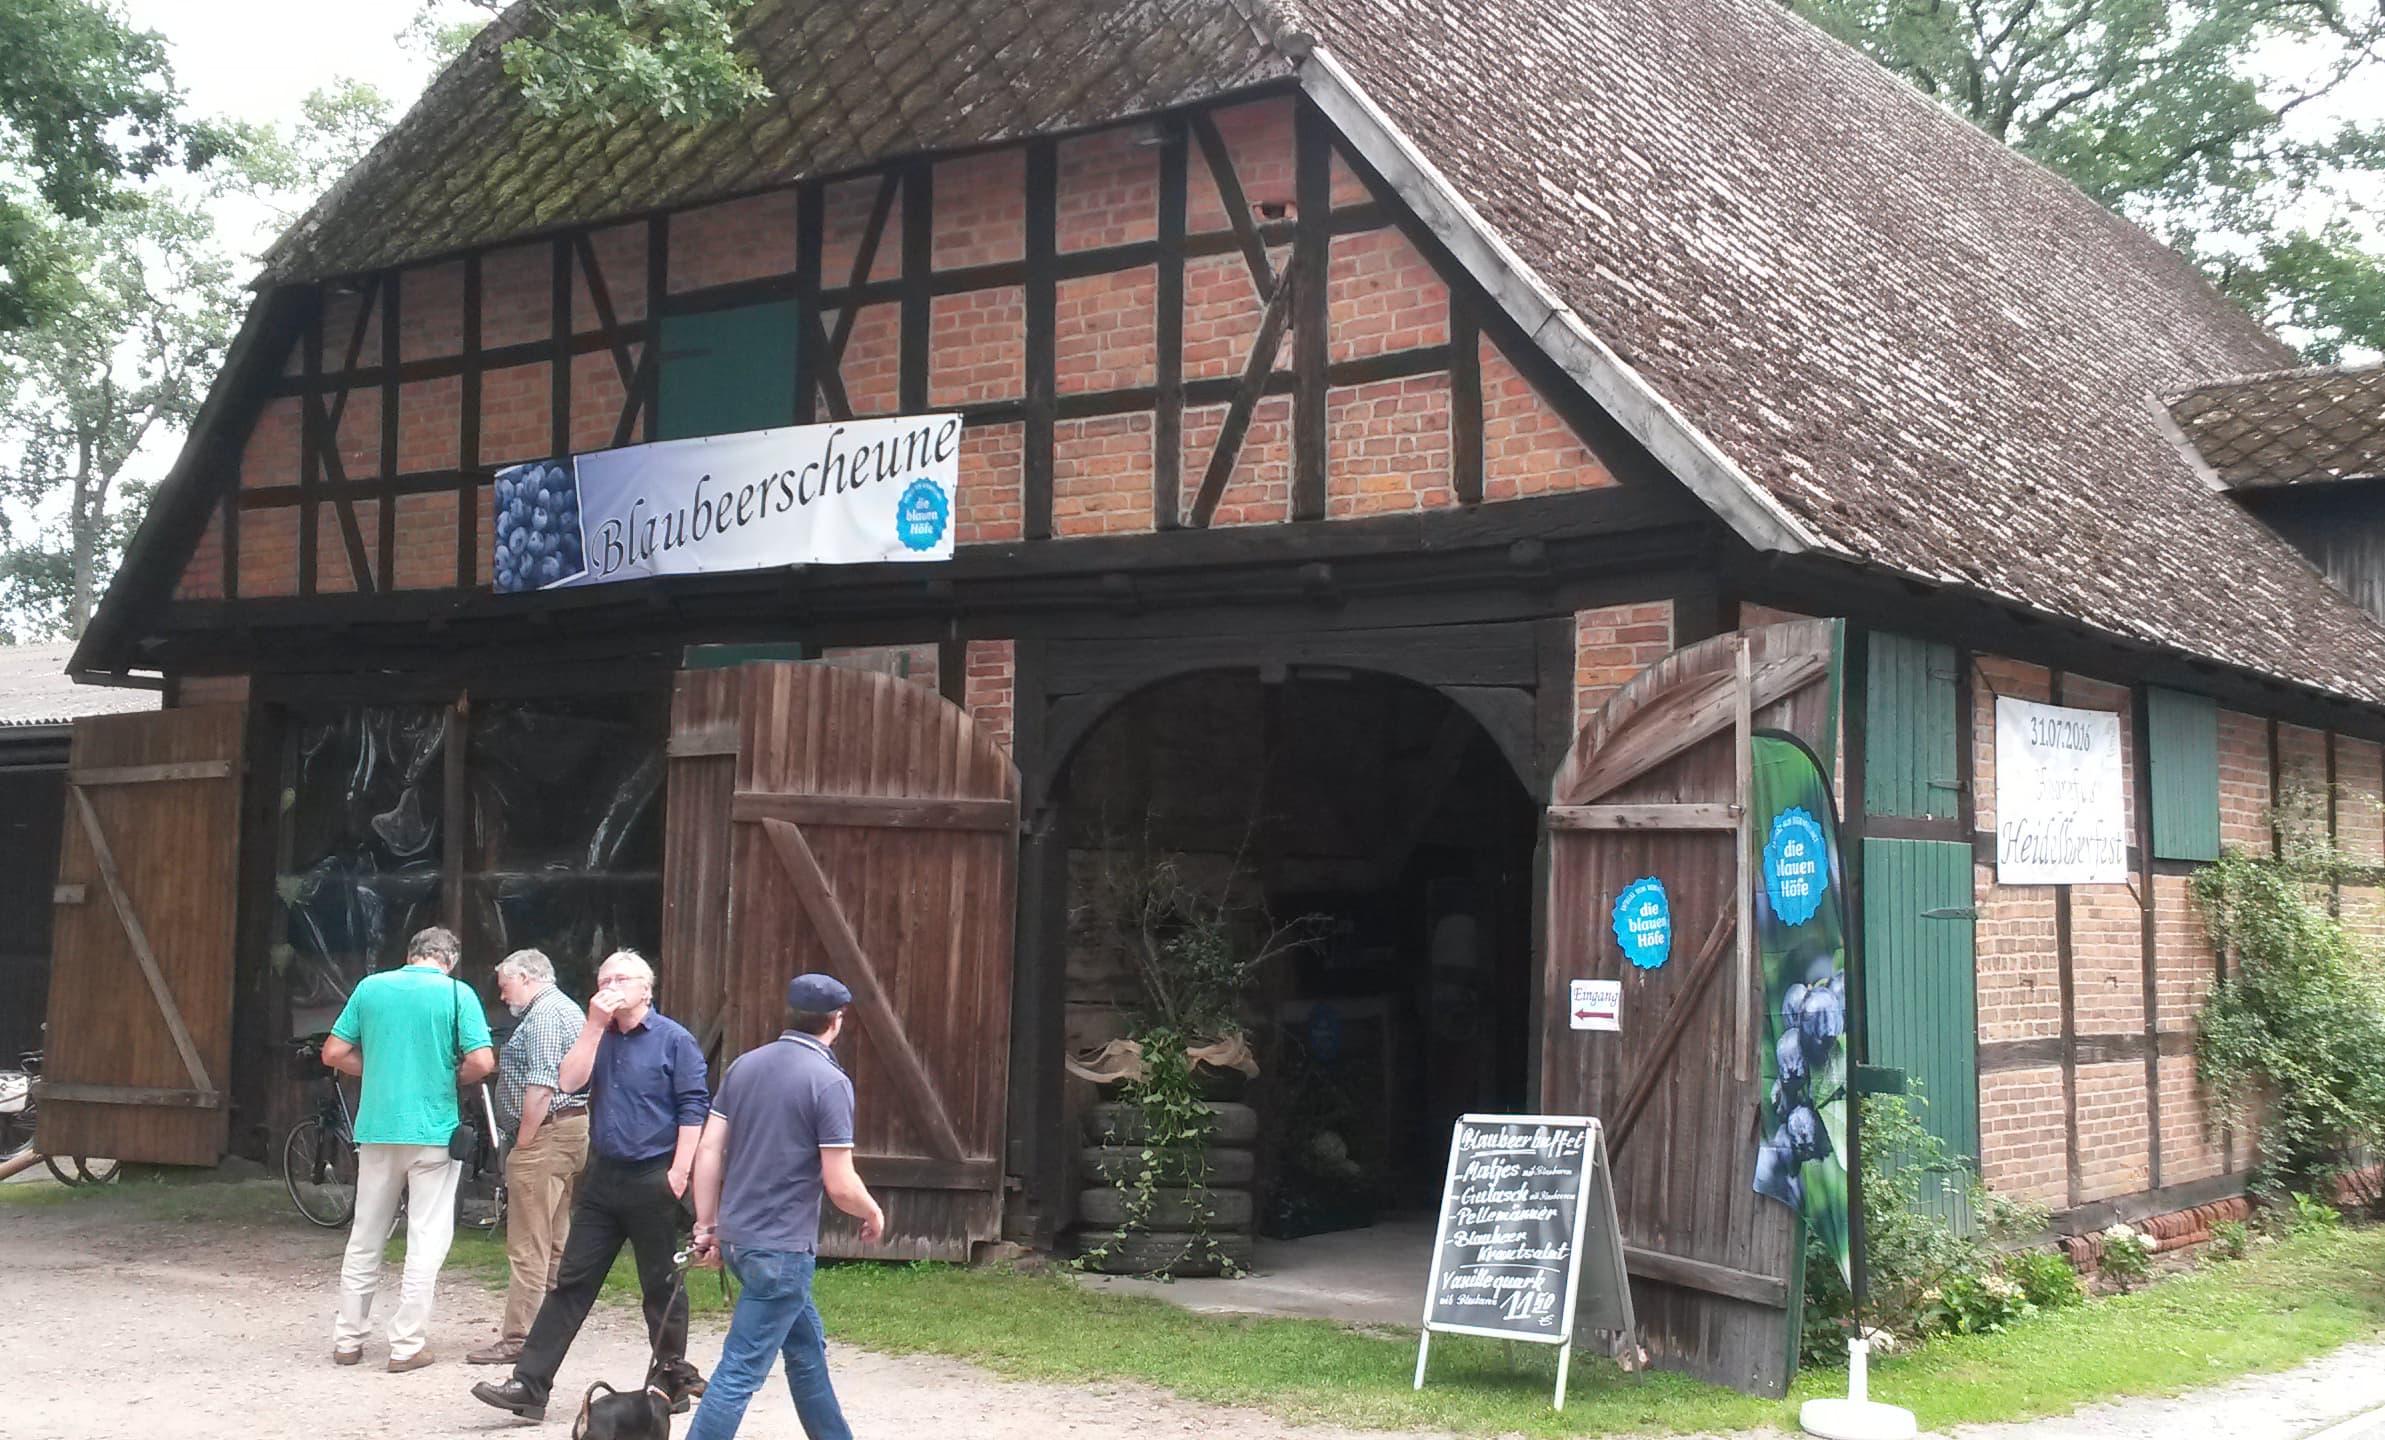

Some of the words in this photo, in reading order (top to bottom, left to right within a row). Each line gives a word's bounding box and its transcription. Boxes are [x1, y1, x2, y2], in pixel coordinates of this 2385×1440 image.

[590, 417, 958, 580] Blaubeerscheune
[2030, 716, 2091, 752] 31.07.2016
[1784, 839, 1805, 858] die
[1780, 877, 1809, 898] Höfe
[1640, 902, 1659, 917] die
[1628, 917, 1668, 933] blauen
[1637, 930, 1665, 948] Höfe
[1573, 987, 1619, 1008] Eingang
